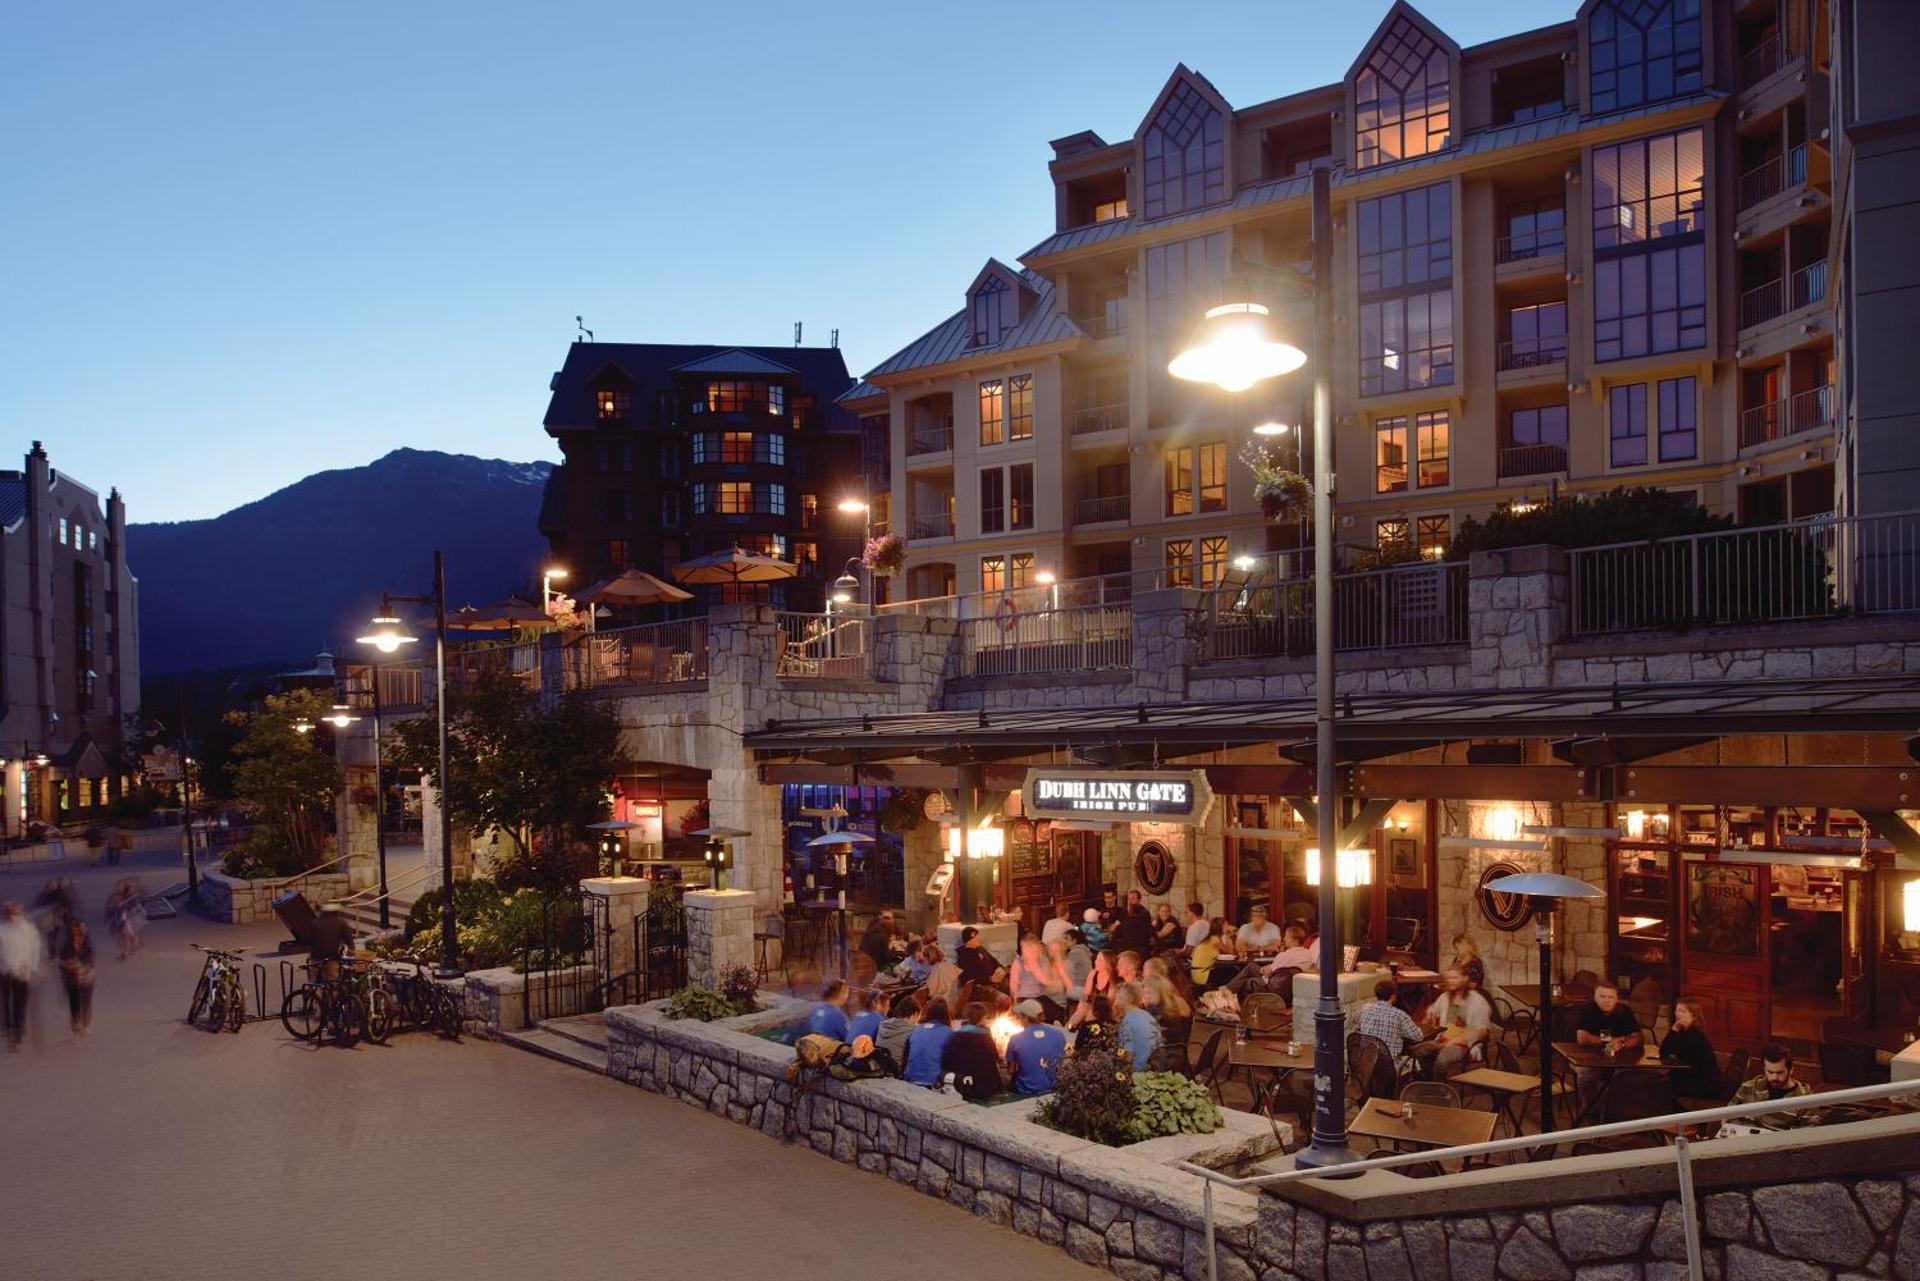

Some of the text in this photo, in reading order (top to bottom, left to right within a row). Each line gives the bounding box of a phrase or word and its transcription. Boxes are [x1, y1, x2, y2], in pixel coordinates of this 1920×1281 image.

[1039, 780, 1186, 803] DUBH LINN GATE
[1073, 800, 1147, 811] IRISH PUB
